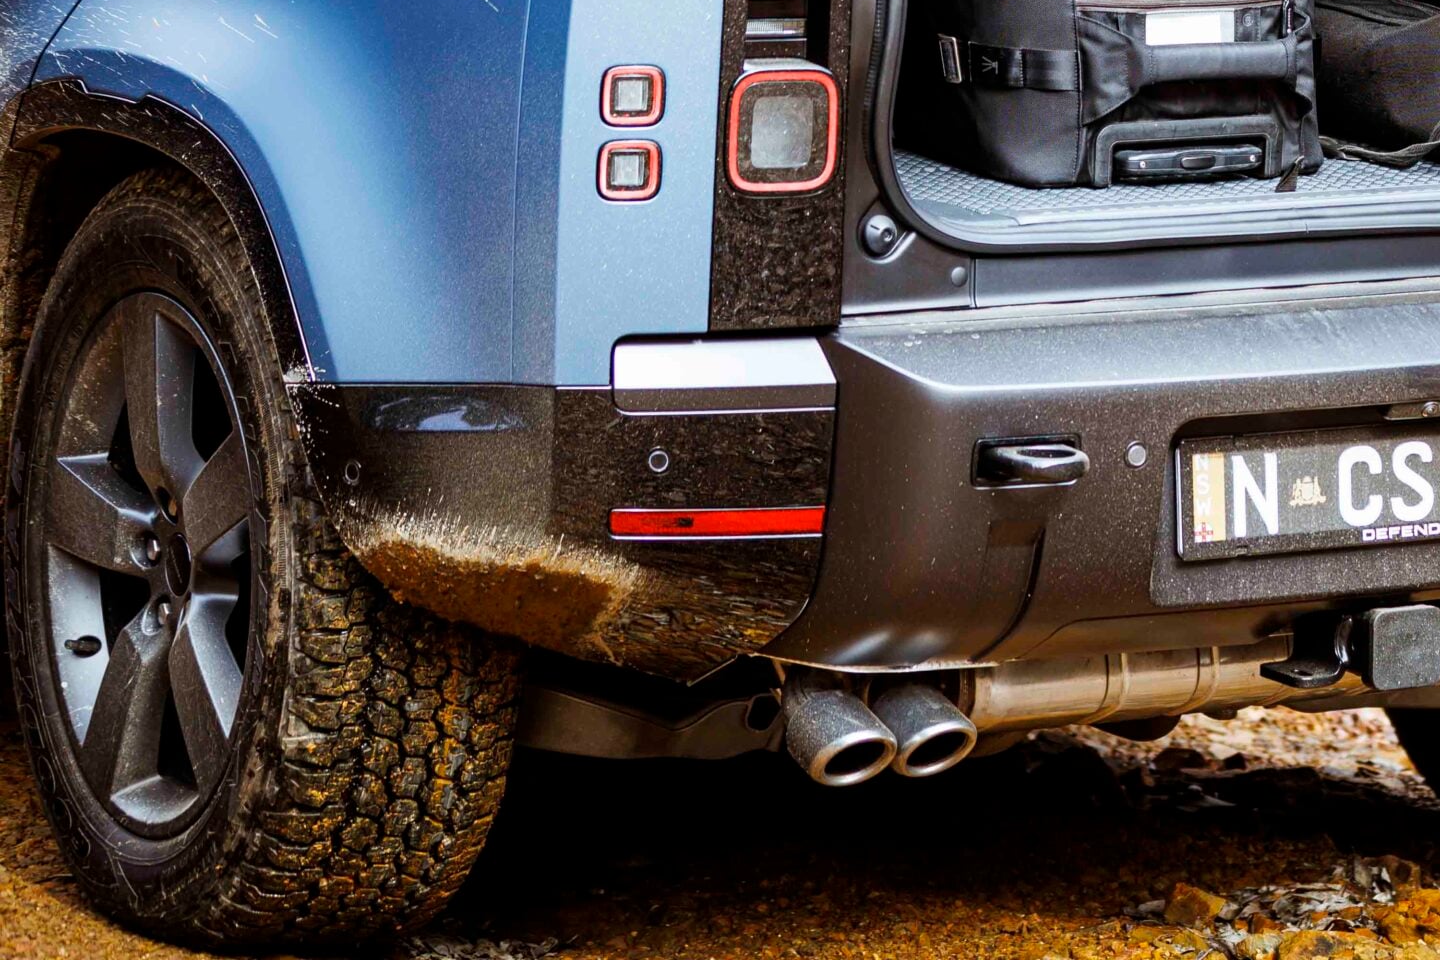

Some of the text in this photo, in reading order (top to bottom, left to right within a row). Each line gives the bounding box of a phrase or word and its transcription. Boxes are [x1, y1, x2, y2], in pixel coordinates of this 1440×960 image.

[1195, 453, 1213, 516] NSW
[1231, 451, 1279, 538] N
[1337, 440, 1435, 527] CS
